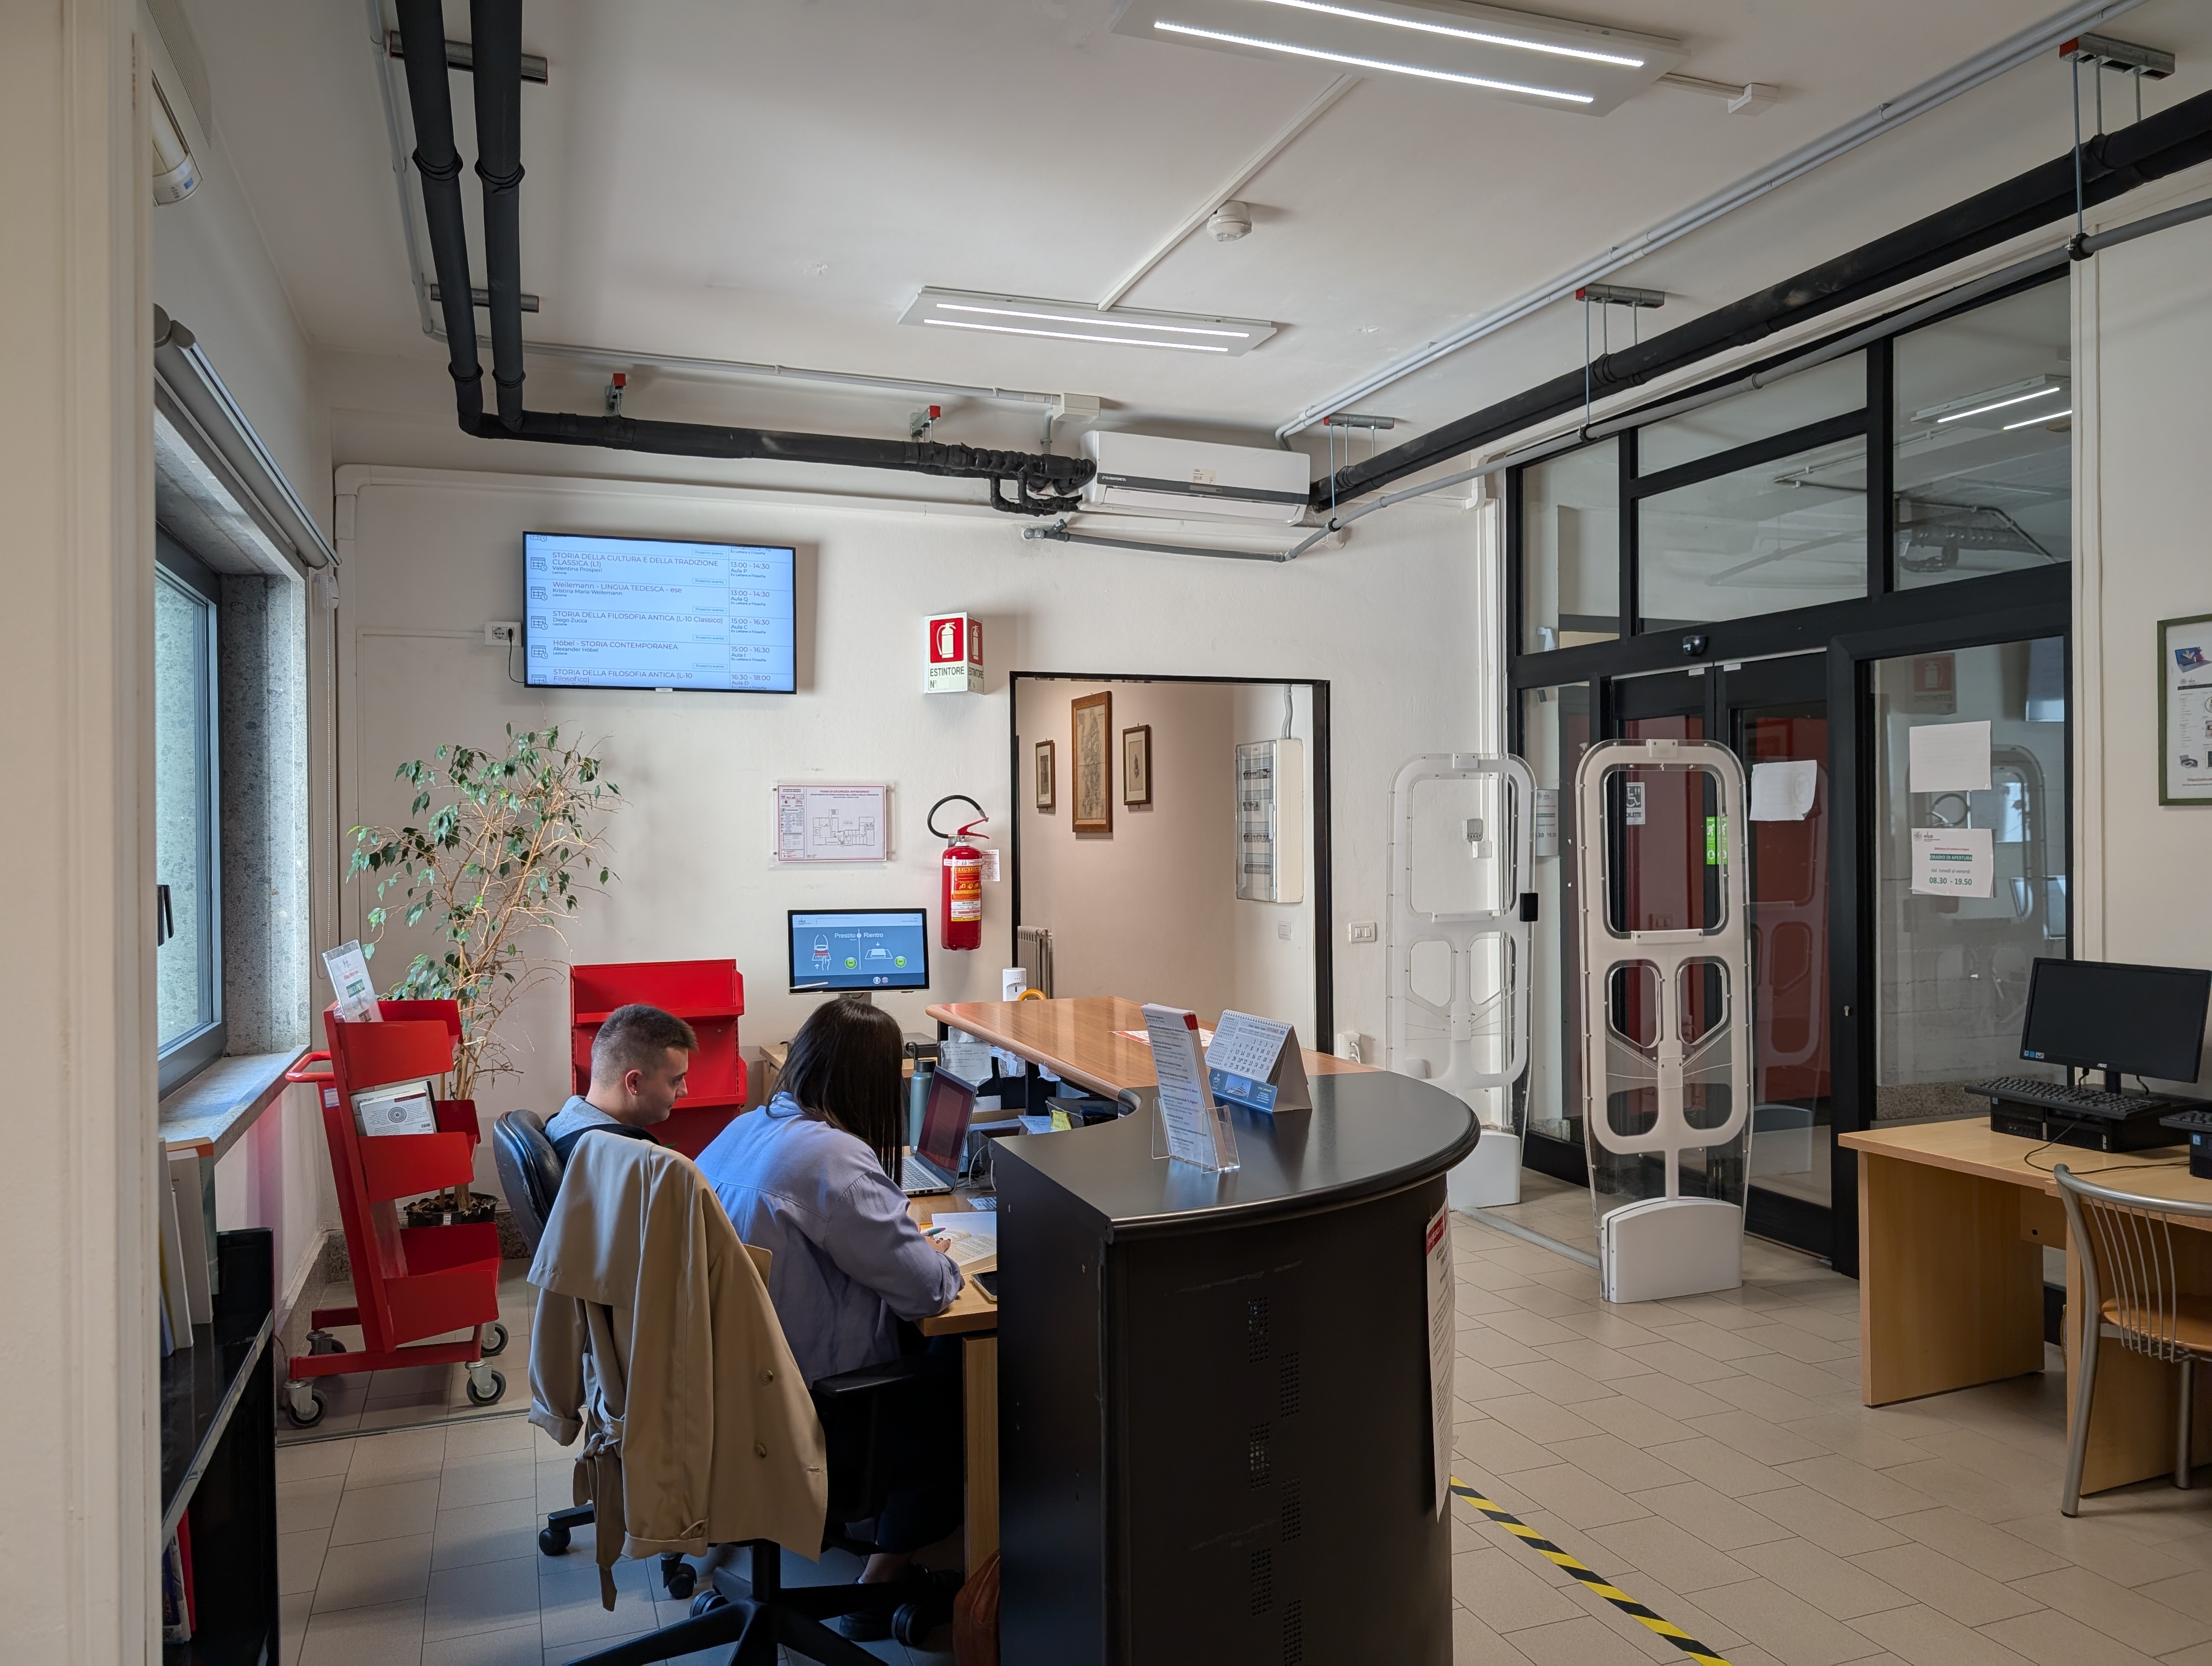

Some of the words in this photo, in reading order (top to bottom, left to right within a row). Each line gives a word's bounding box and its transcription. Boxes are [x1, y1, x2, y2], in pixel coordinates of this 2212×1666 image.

[674, 559, 718, 567] TRADIZIONE
[694, 616, 723, 624] Classico)
[609, 642, 678, 650] CONTEMPORANEA
[930, 666, 964, 677] ESTINTORE
